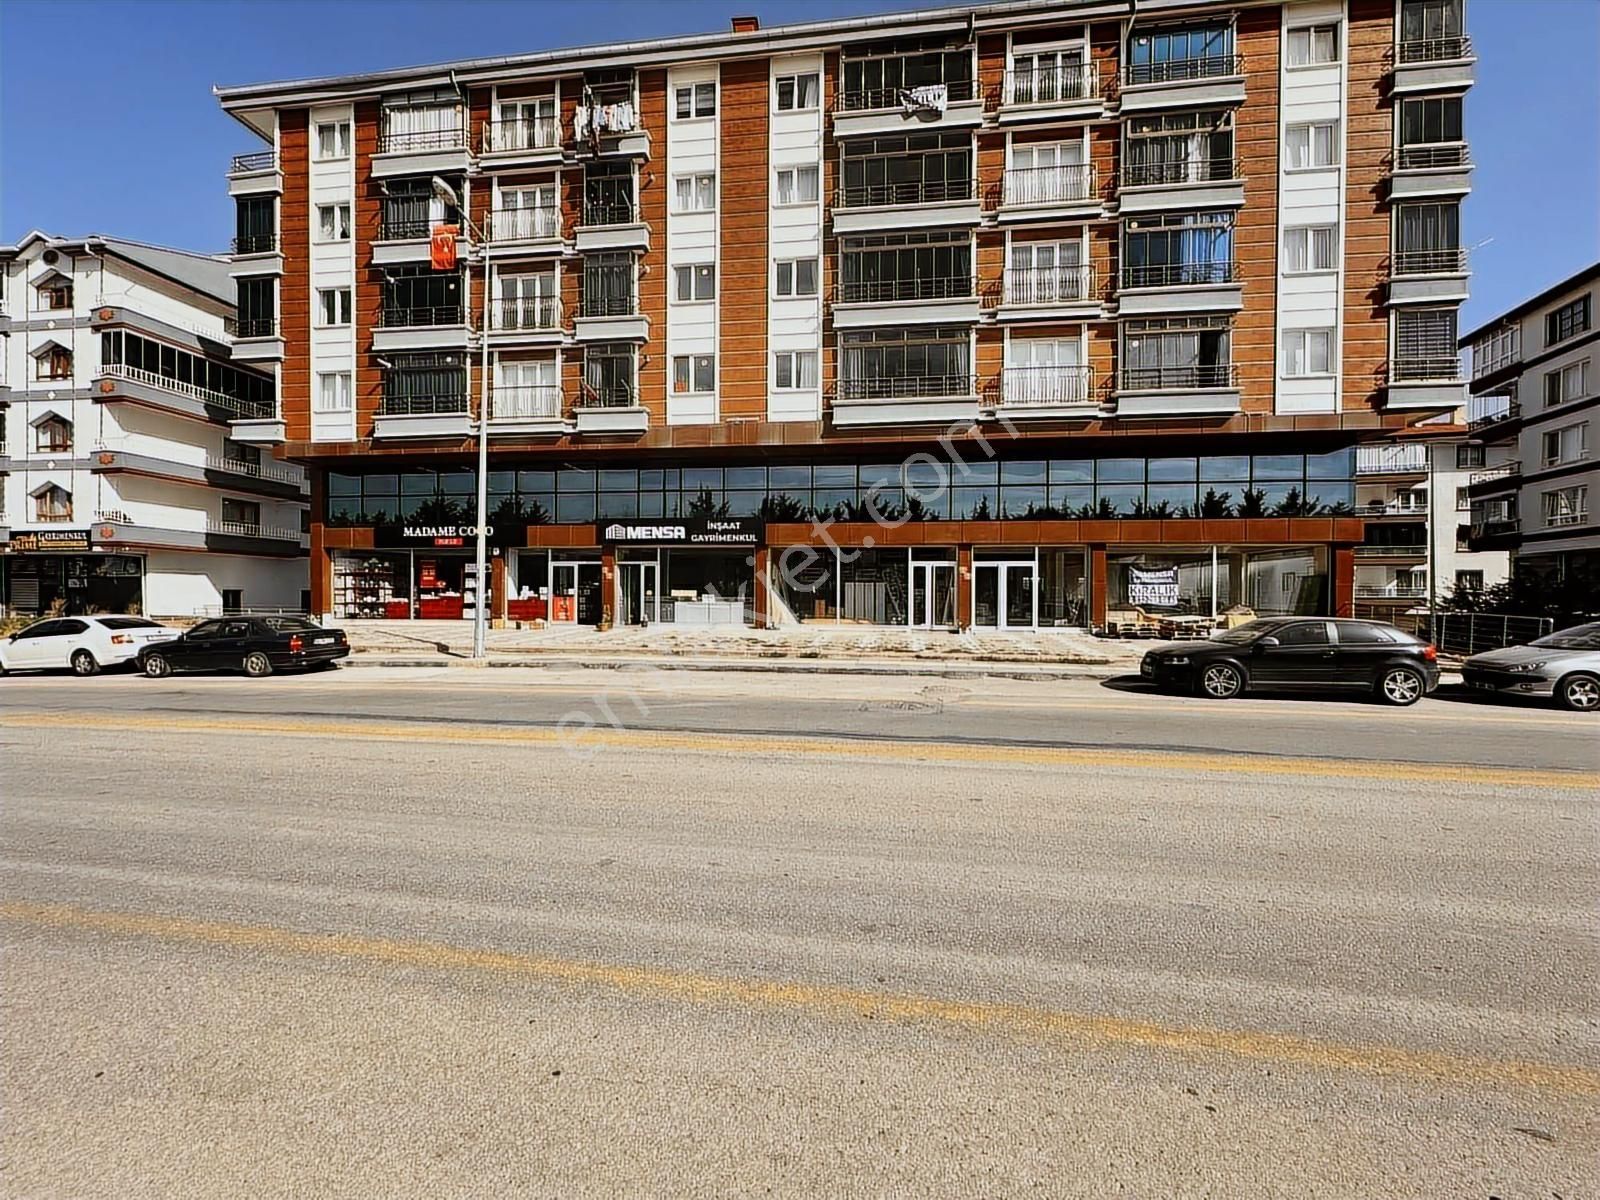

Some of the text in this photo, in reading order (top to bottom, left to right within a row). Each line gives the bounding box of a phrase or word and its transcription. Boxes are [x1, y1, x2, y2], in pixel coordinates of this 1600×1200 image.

[403, 526, 494, 537] MADAME COO
[707, 520, 742, 532] İNŞAAT
[627, 526, 686, 540] MENSA
[690, 532, 758, 542] GAYRİMENKUL
